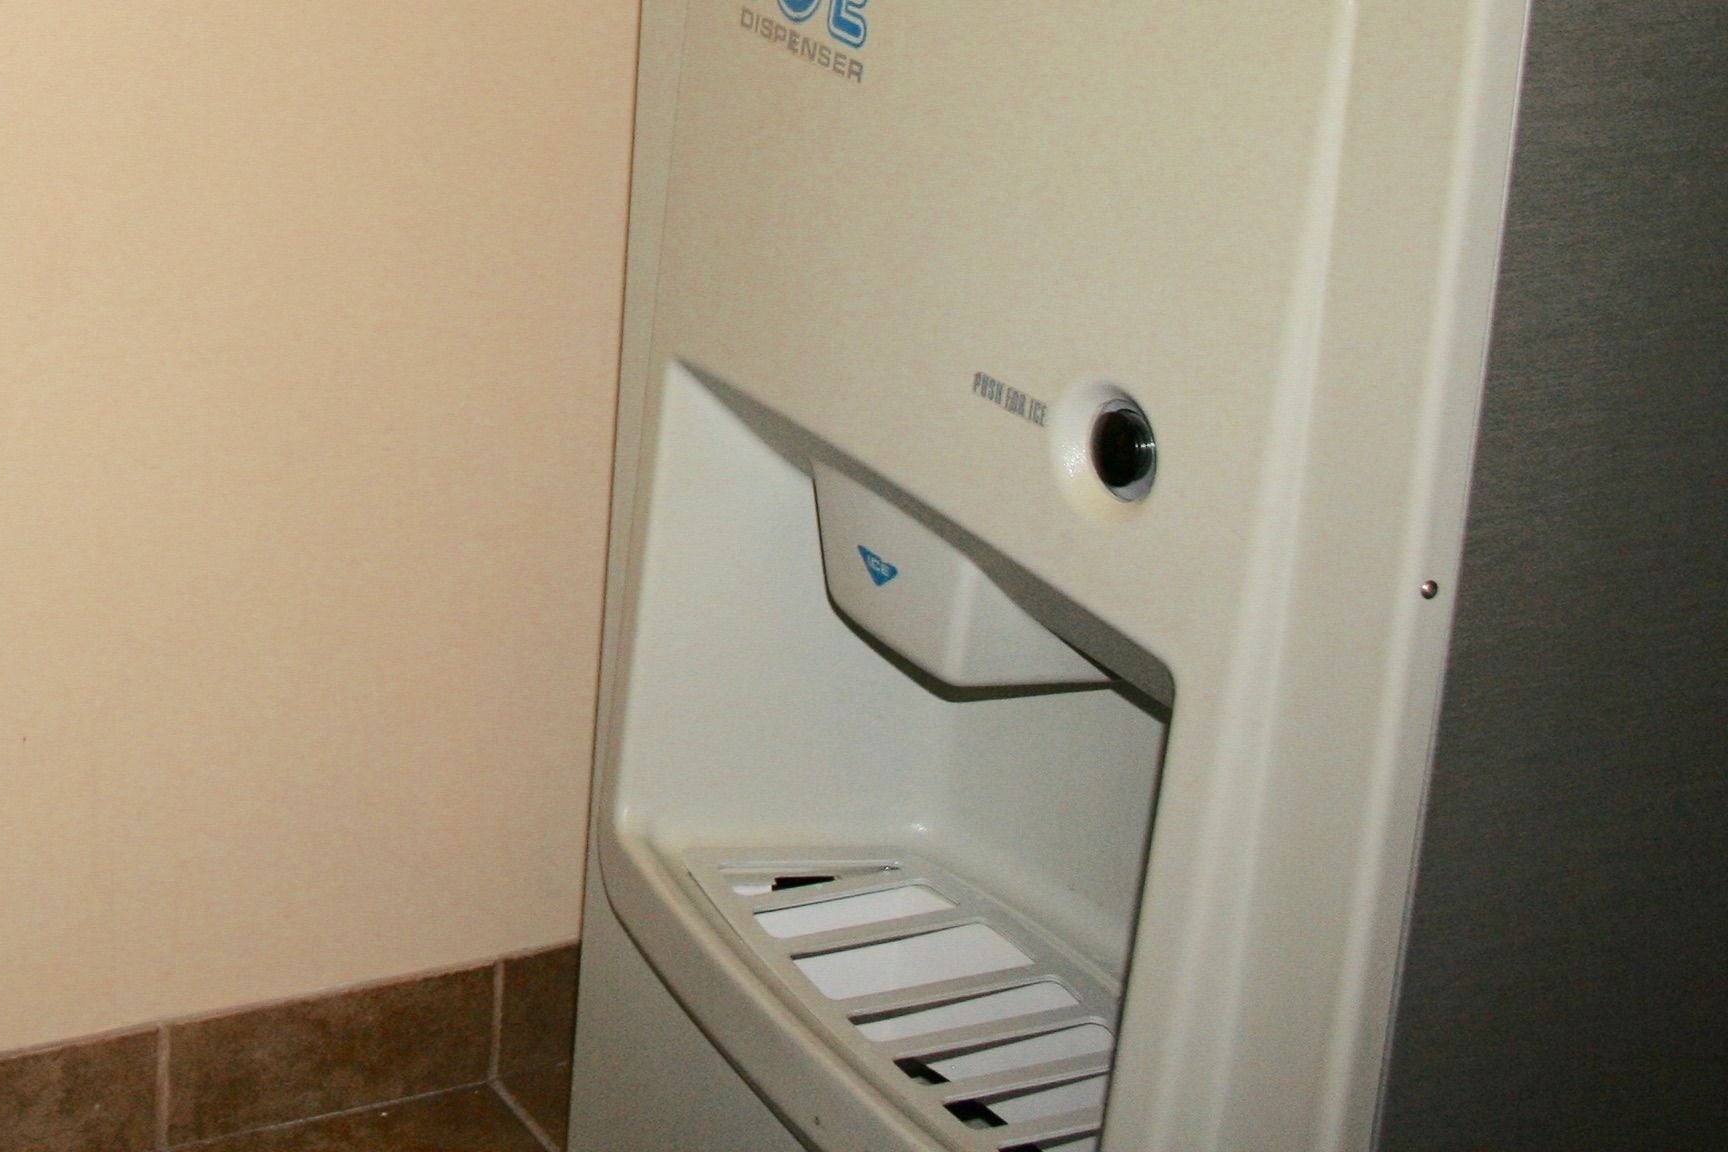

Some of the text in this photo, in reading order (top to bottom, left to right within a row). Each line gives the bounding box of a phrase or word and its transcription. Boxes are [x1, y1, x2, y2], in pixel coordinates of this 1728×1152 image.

[740, 6, 864, 84] DISPENSER
[973, 371, 1048, 428] PUSH FOR ICE
